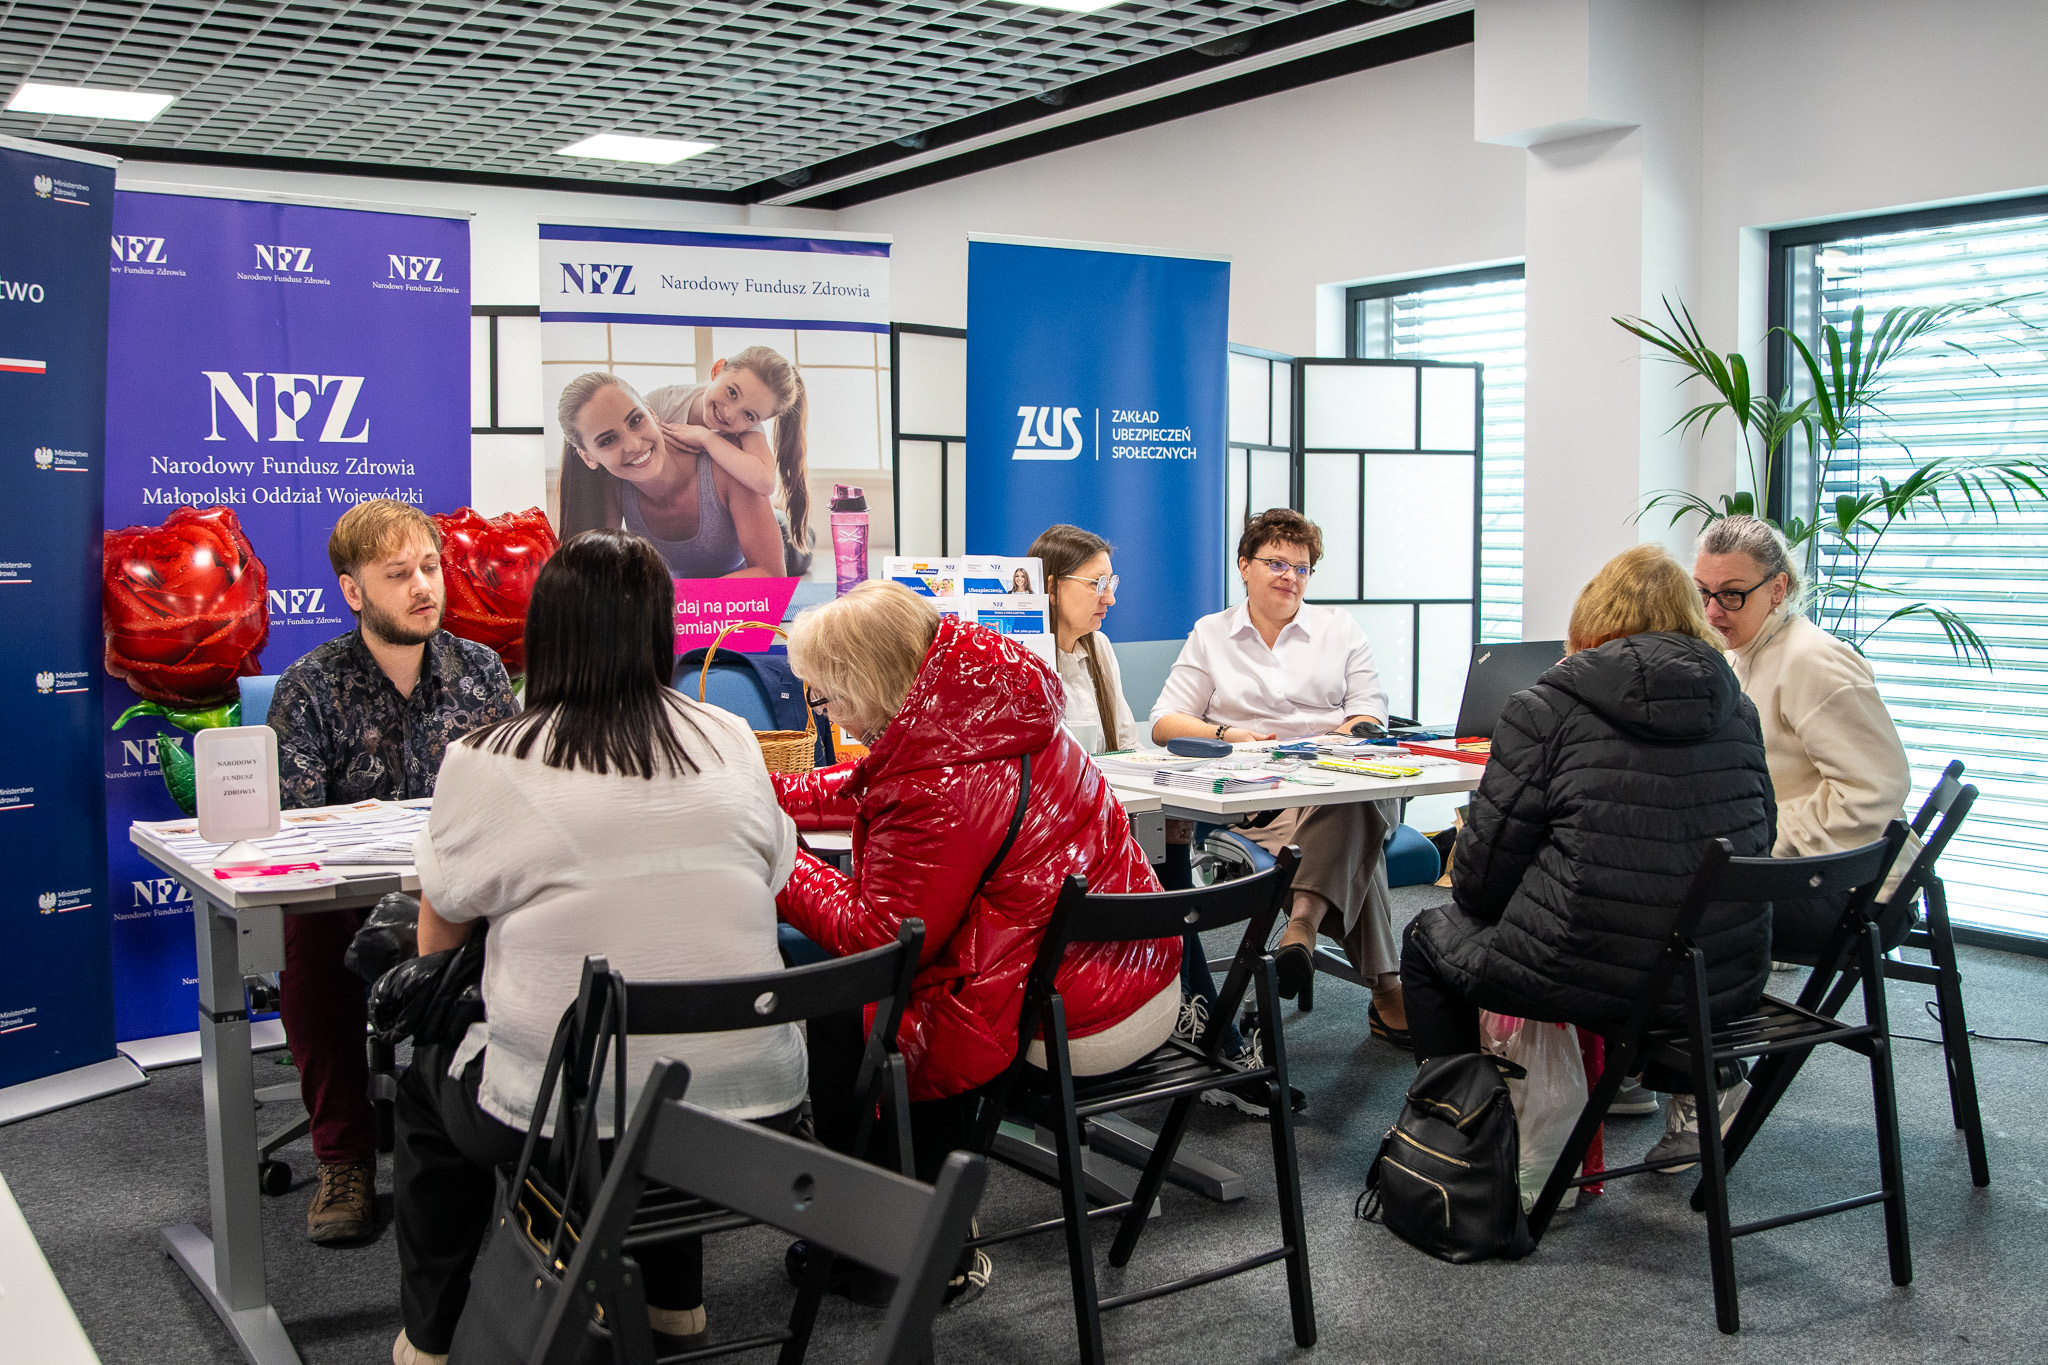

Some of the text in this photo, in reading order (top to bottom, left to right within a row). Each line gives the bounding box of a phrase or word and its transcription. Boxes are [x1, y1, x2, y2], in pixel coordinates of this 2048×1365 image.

[54, 179, 90, 192] Ministerstwo
[54, 187, 77, 198] Zdrowia
[111, 235, 168, 264] NFZ
[254, 244, 314, 272] NFZ
[124, 266, 155, 275] Fundusz
[156, 267, 187, 277] Zdrowia
[388, 254, 443, 282] NFZ
[237, 272, 331, 286] Narodowy Fundusz Zdrowia
[559, 263, 636, 296] NFZ
[372, 281, 460, 294] Narodowy Fundusz Zdrowia
[661, 274, 870, 298] Narodowy Fundusz Zdrowia
[201, 371, 370, 443] NFZ
[1112, 410, 1159, 424] ZAKŁAD
[1011, 405, 1083, 461] ZUS
[1112, 426, 1191, 442] UBEZPIECZEŃ
[54, 449, 89, 458] Ministerstwo
[1112, 447, 1197, 460] SPOŁECZNYCH
[54, 457, 77, 465] Zdrowia
[150, 456, 415, 477] Narodowy Fundusz Zdrowia
[142, 487, 424, 508] Małopolski Oddział Wojewódzki
[268, 588, 325, 615] NFZ
[673, 597, 770, 617] daj na portal
[287, 617, 315, 626] Fundusz
[316, 616, 342, 624] Zdrowia
[55, 671, 89, 679] Ministerstwo
[55, 680, 78, 688] Zdrowia
[217, 758, 258, 767] NARODOWY
[222, 774, 254, 782] FUNDUSZ
[223, 788, 256, 796] ZDROWIA
[57, 887, 92, 899] Ministerstwo
[131, 877, 194, 908] NFZ
[57, 897, 80, 907] Zdrowia
[113, 910, 152, 921] Narodowy
[153, 907, 184, 917] Fundusz
[0, 1017, 23, 1028] Zdrowia
